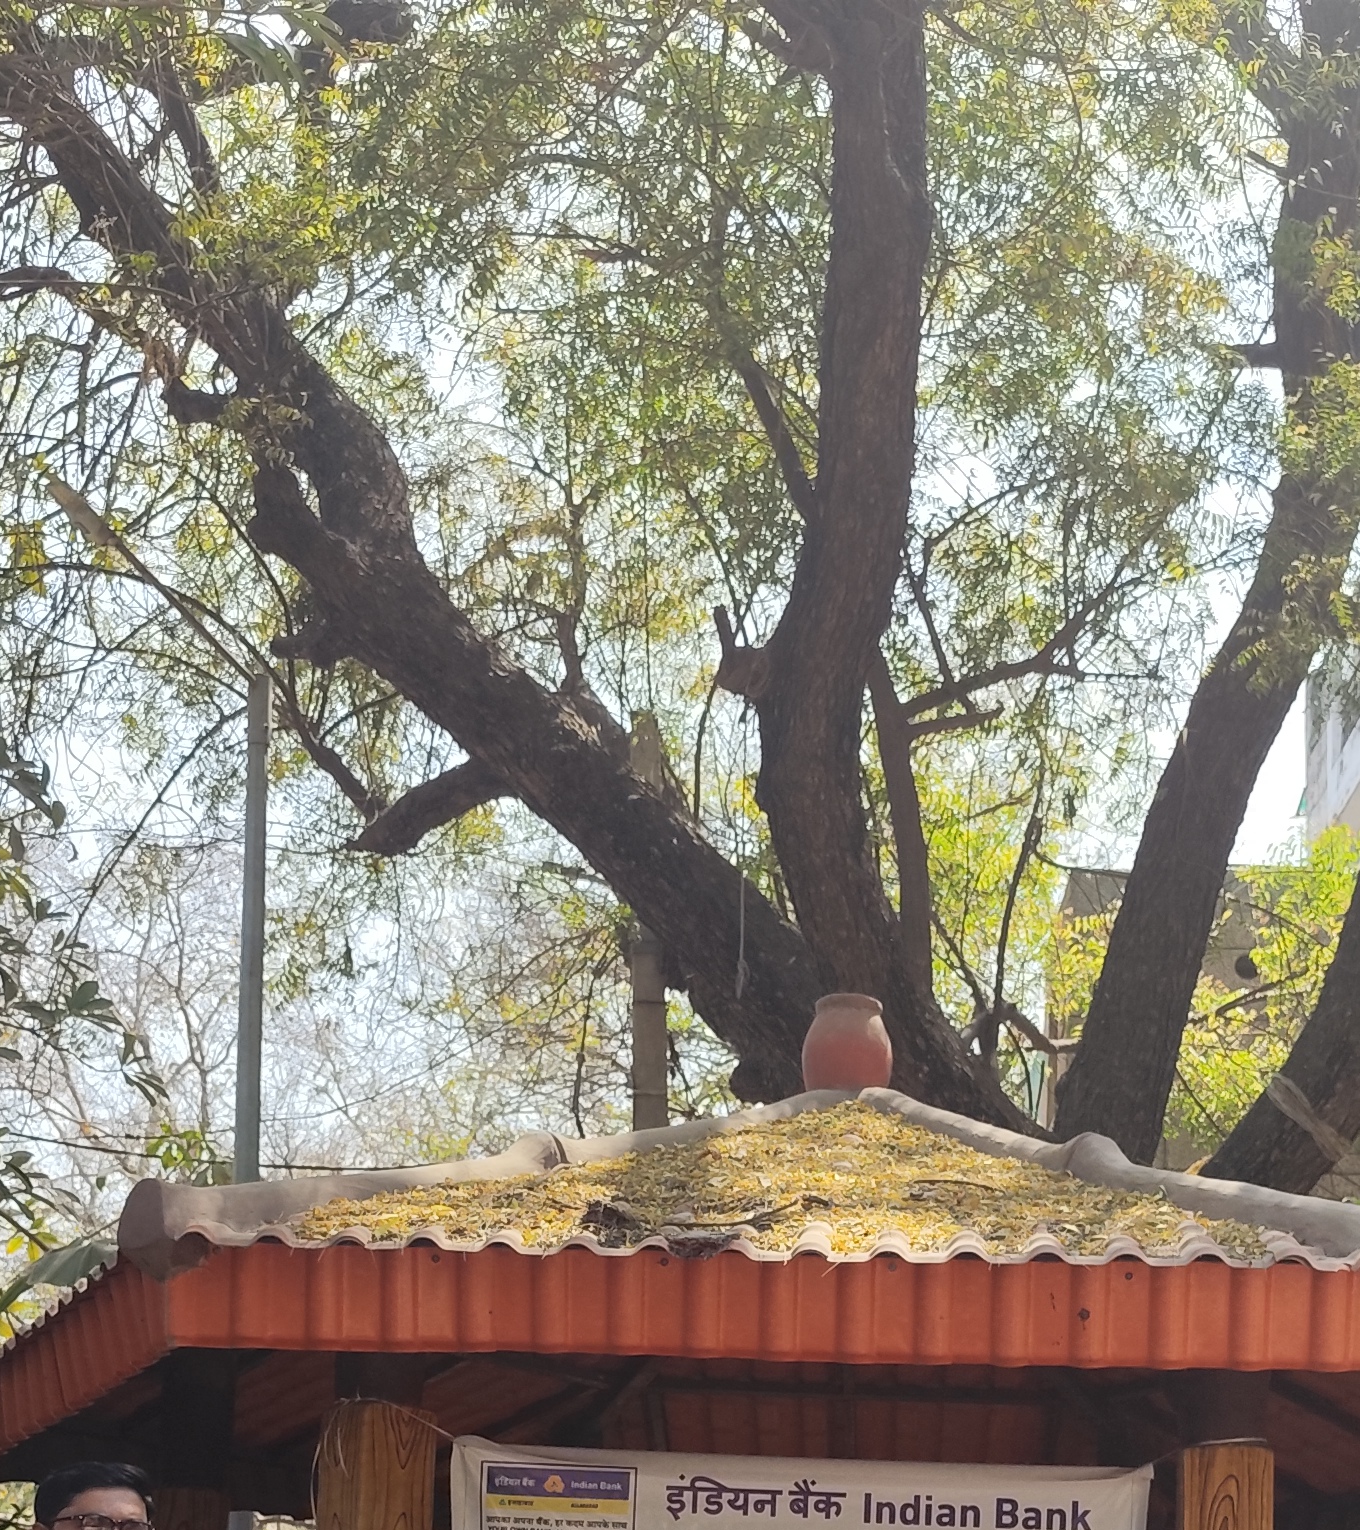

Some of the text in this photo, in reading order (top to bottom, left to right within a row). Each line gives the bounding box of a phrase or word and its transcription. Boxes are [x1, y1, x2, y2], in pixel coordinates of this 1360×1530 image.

[571, 1481, 622, 1491] Indian Bank
[666, 1474, 846, 1521] इंडियन बैंक
[863, 1492, 981, 1528] Indian
